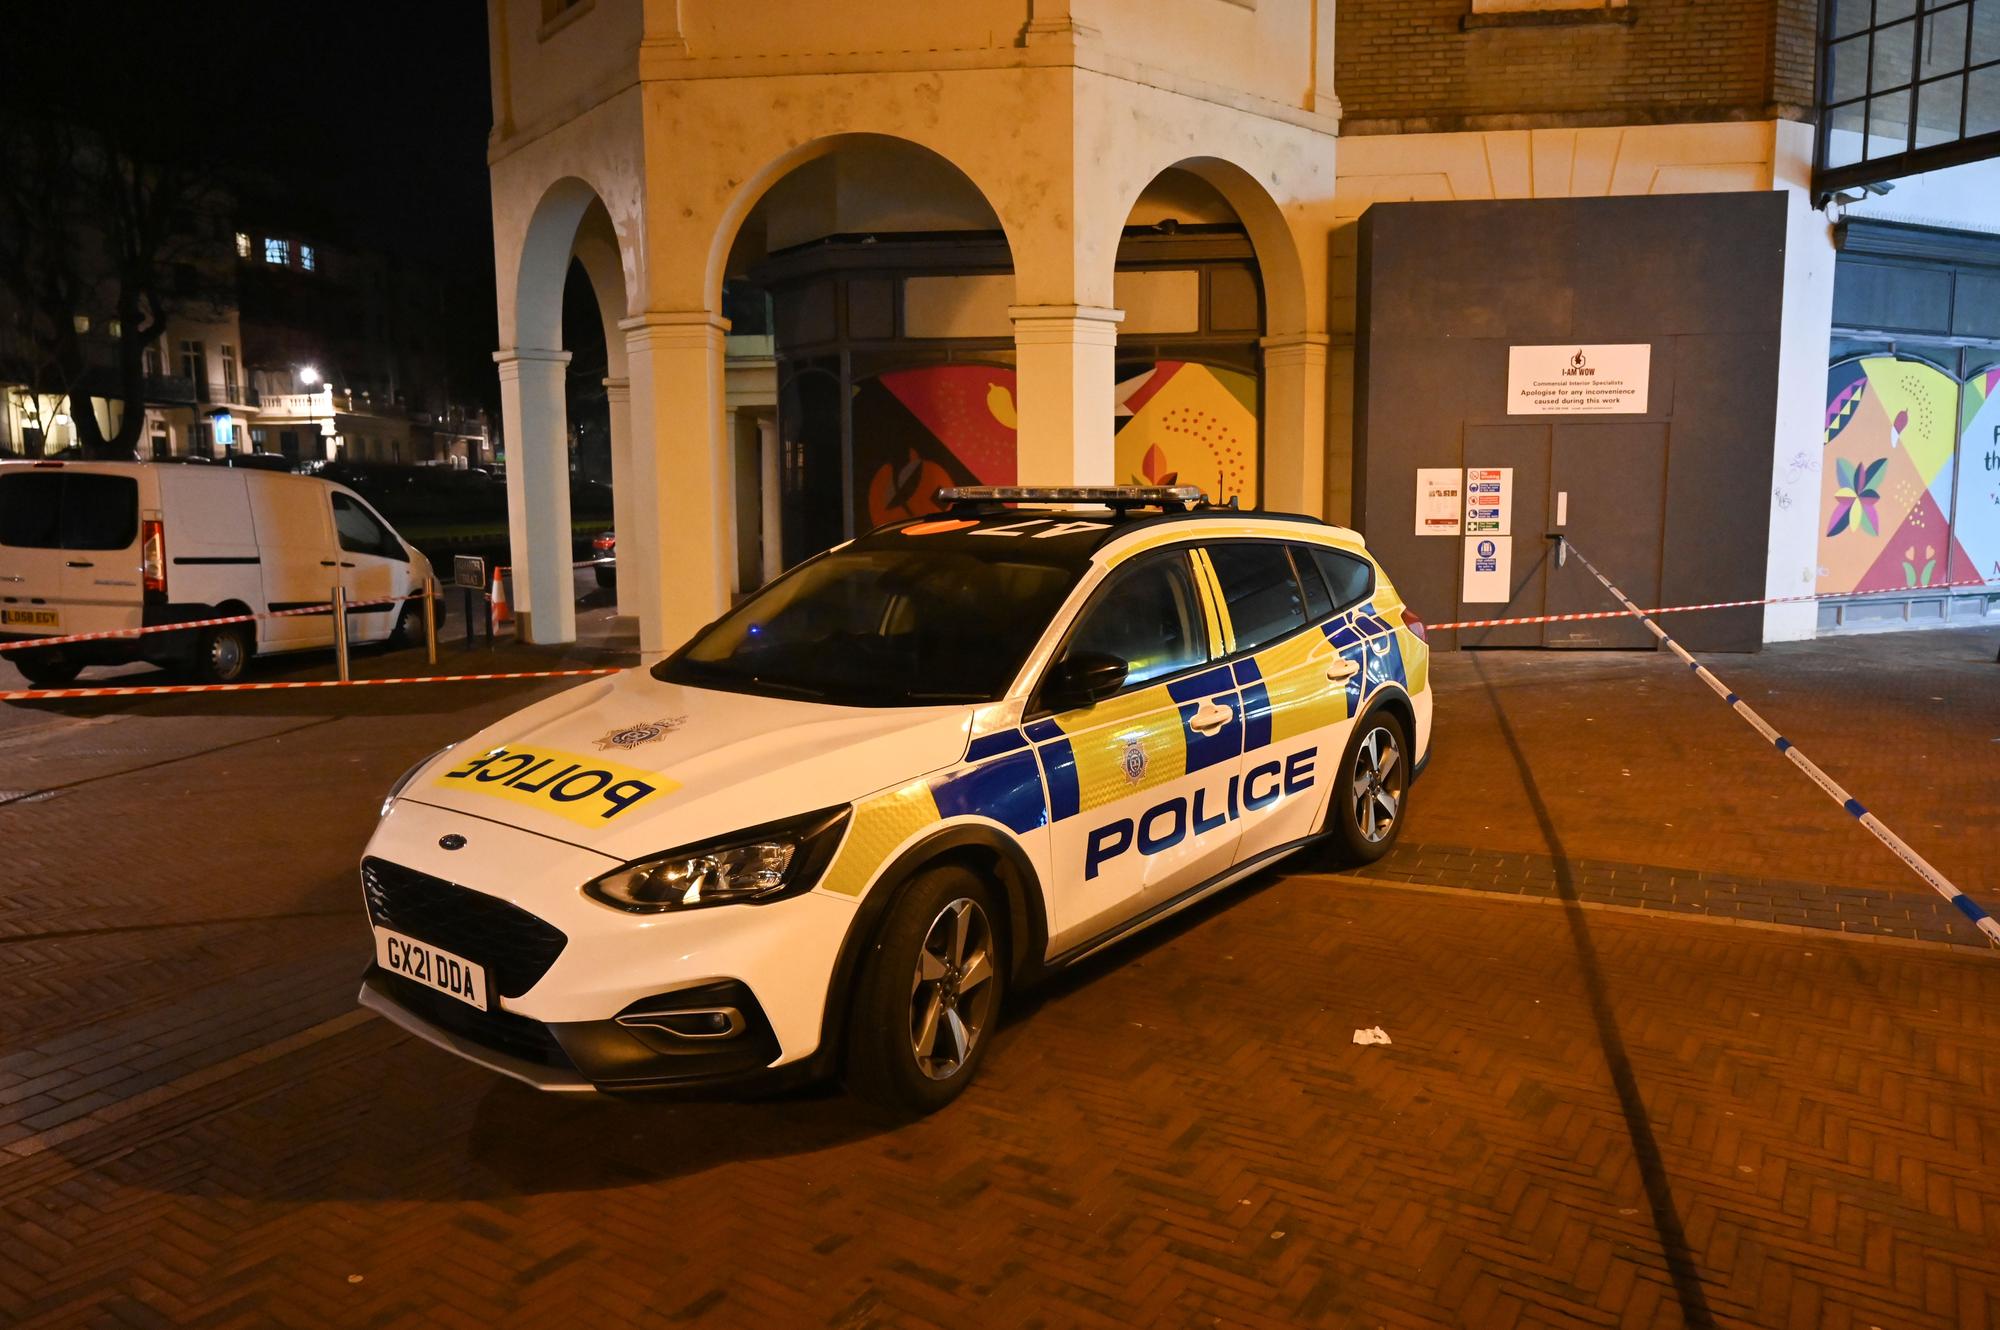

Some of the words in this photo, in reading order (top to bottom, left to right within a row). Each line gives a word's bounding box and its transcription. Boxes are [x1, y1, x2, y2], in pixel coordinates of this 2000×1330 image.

[1562, 368, 1577, 376] I-AM
[1579, 368, 1595, 376] WOW
[1521, 389, 1556, 397] Apologise
[1561, 398, 1584, 406] during
[1085, 746, 1318, 881] POLICE
[387, 936, 432, 982] GX21
[436, 954, 475, 1001] DDA
